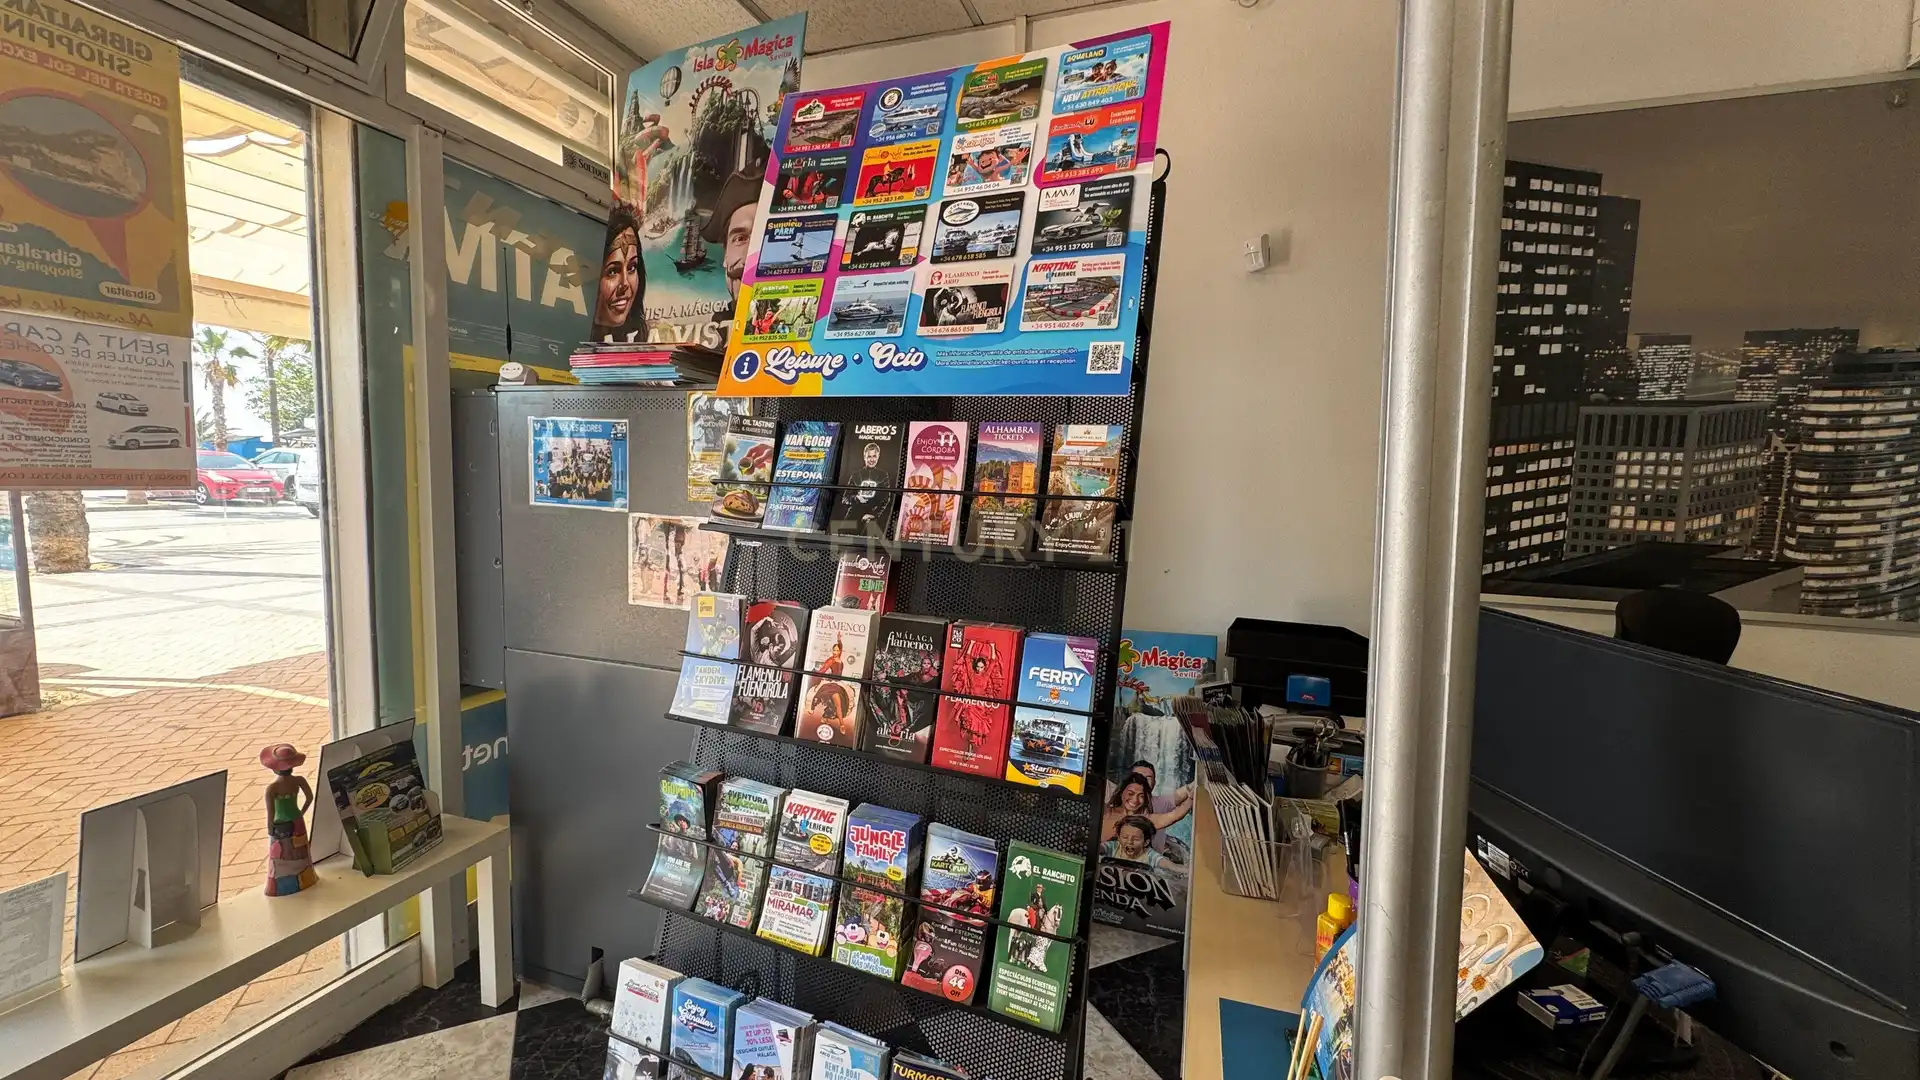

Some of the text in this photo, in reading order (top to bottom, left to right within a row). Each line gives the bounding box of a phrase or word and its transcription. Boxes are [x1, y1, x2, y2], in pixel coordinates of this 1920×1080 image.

[693, 35, 795, 74] Isla Mágica
[770, 52, 792, 63] Sevilla
[1067, 49, 1105, 64] AQUALAND
[1062, 93, 1080, 104] NEW
[767, 220, 802, 231] Sunview
[774, 227, 795, 236] PARK
[1032, 260, 1079, 273] KARTING
[944, 271, 980, 279] FLAMENCO
[680, 299, 730, 318] MÁGICA
[949, 350, 982, 358] información
[1046, 347, 1078, 356] recepción
[764, 341, 928, 384] Leisure Ocio
[935, 359, 950, 367] More
[949, 359, 982, 367] information
[1011, 358, 1039, 367] purchase
[1046, 357, 1076, 367] reception
[752, 420, 775, 430] TASTING
[985, 424, 1034, 435] ALHAMBRA
[785, 434, 833, 447] VAN GOGH
[916, 437, 939, 448] ENJOY
[994, 432, 1025, 442] TICKETS
[921, 445, 956, 454] CÓRDOBA
[776, 469, 823, 480] ESTEPONA
[785, 496, 805, 504] JUNIO
[776, 504, 813, 514] SEPTIEMBRE
[1064, 511, 1083, 521] ENJOY
[816, 619, 866, 633] FLAMENCO
[884, 631, 934, 654] flamenco
[896, 631, 933, 644] MÁLAGA
[1141, 646, 1204, 671] Mágica
[1028, 666, 1086, 688] FERRY
[1173, 670, 1203, 681] Sevilla
[738, 680, 789, 700] FUENGIROLA
[1030, 764, 1062, 776] Starfish
[728, 790, 769, 805] AVENTURA
[785, 801, 838, 825] KARTING
[849, 825, 906, 852] JUNGLE
[854, 843, 899, 865] FAMILY
[930, 859, 968, 874] KART FUN
[1032, 865, 1076, 884] EL RANCHITO
[769, 889, 793, 900] CIRCUITO
[767, 897, 814, 920] MIRAMAR
[954, 928, 983, 941] ESTEPONA
[949, 989, 962, 998] Off
[684, 998, 707, 1017] Enjoy
[678, 1005, 718, 1034] Gibraltar
[760, 1036, 773, 1044] LESS
[736, 1048, 757, 1056] DESIGNER
[824, 1060, 839, 1070] RENT
